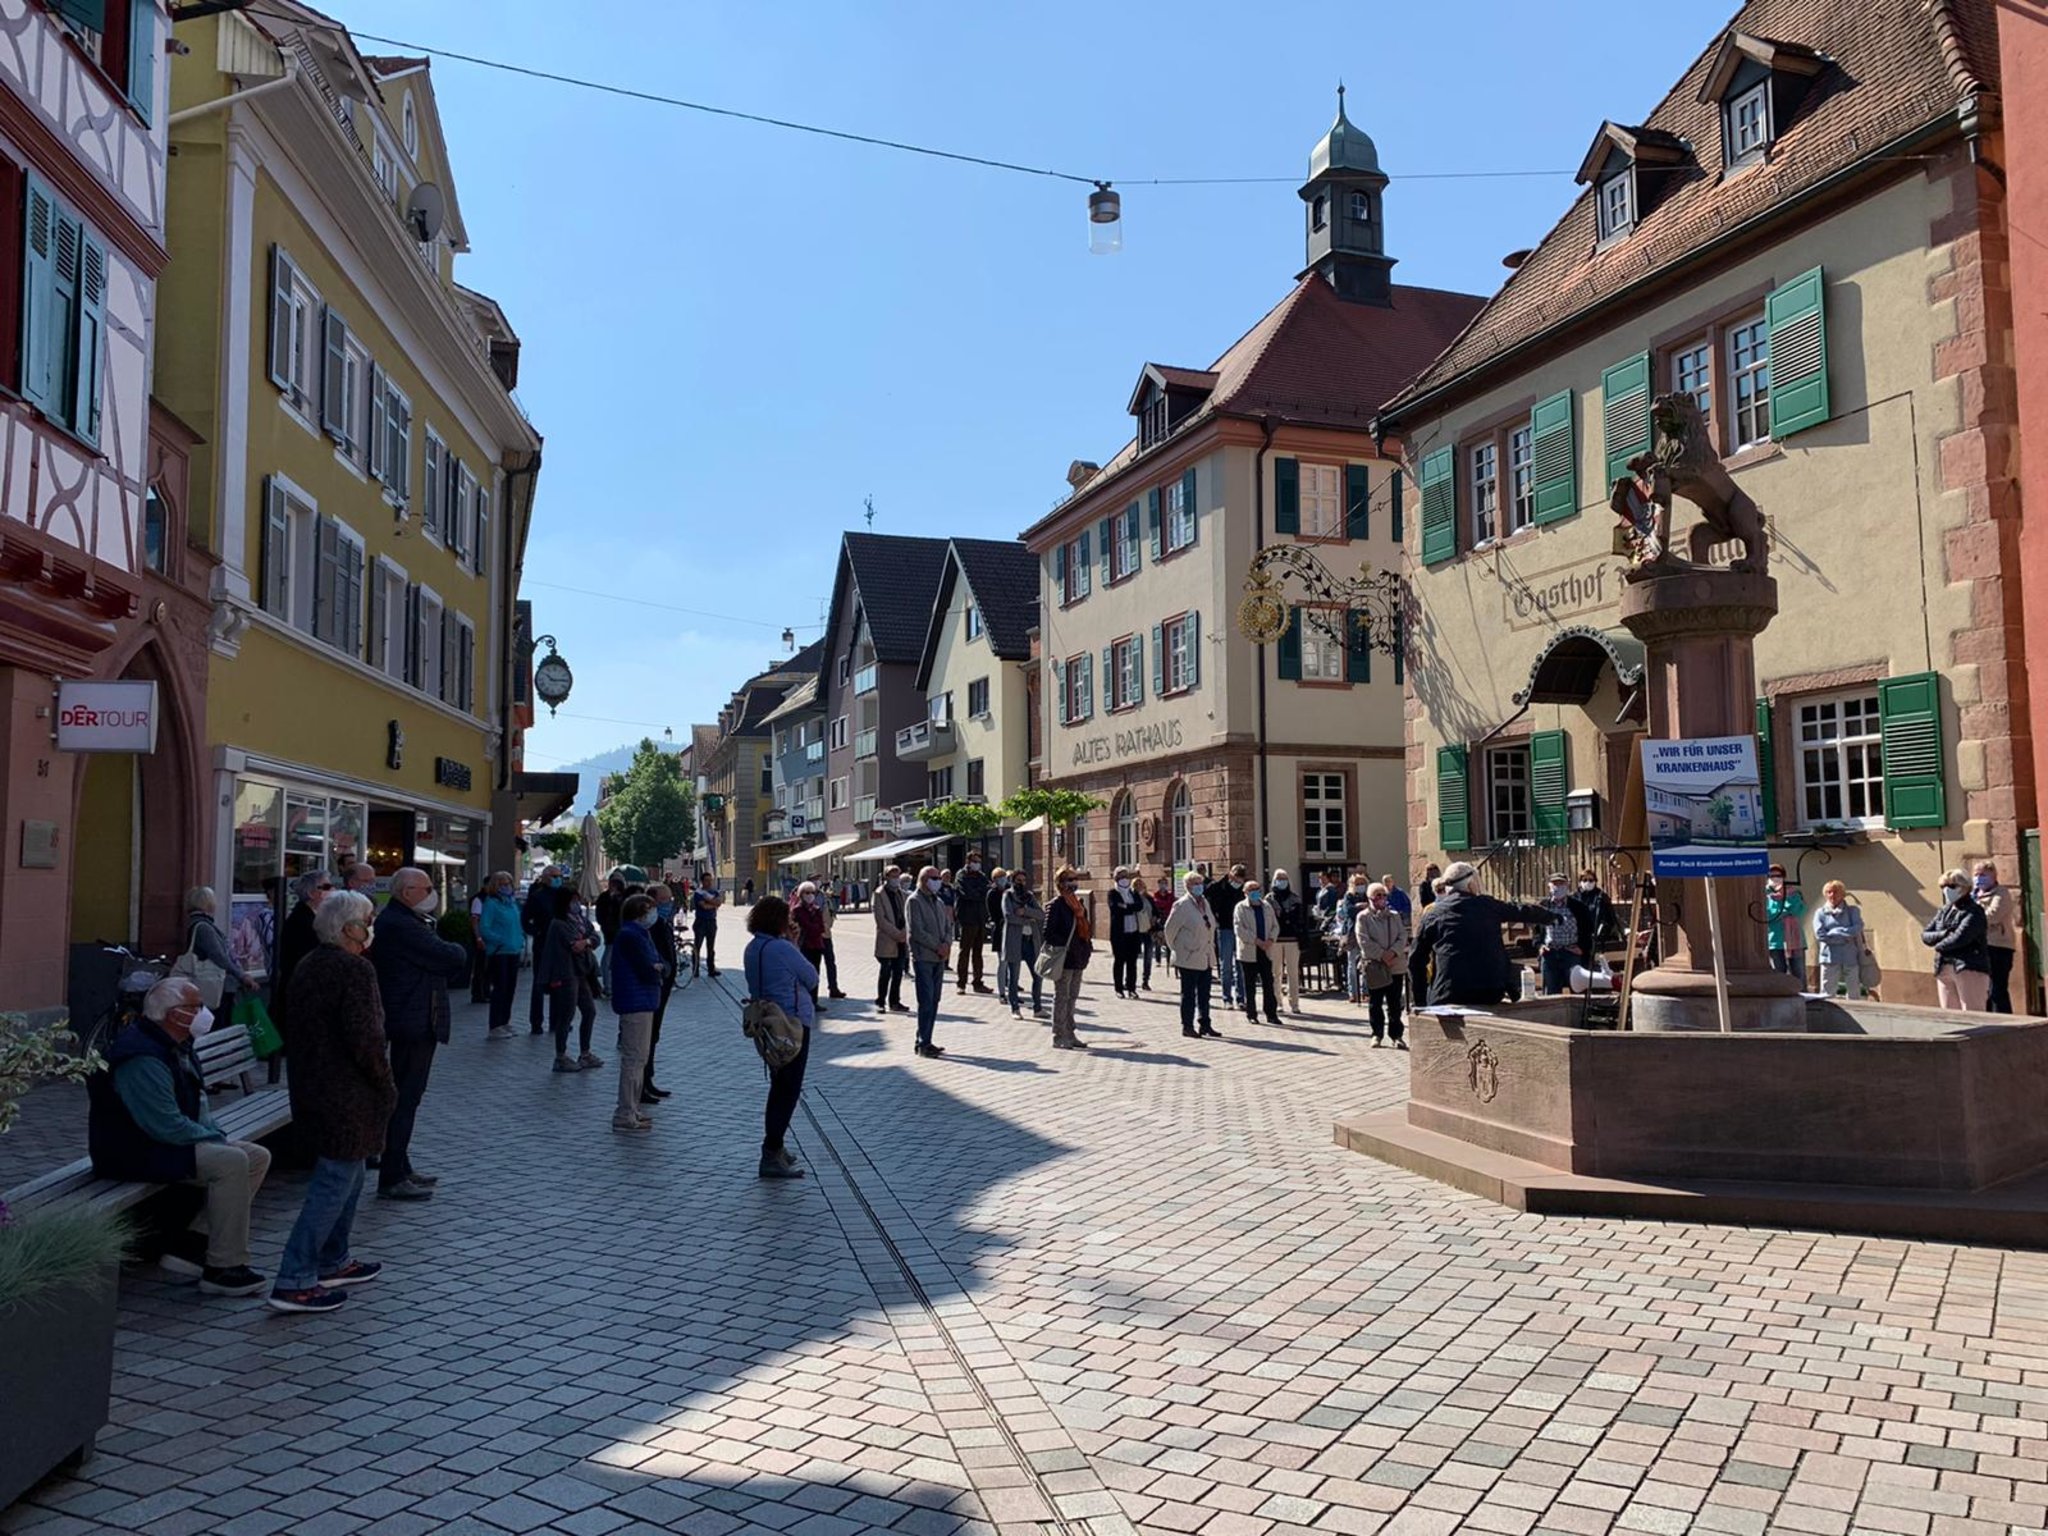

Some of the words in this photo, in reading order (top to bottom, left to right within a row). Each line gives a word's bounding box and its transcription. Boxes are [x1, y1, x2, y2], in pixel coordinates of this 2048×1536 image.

[1513, 562, 1606, 618] Gasthof
[61, 706, 148, 728] DERTOUR
[1072, 737, 1112, 767] ALTES
[1115, 720, 1183, 758] RATHAUS
[1682, 743, 1704, 757] FÜR
[1706, 743, 1743, 756] UNSER
